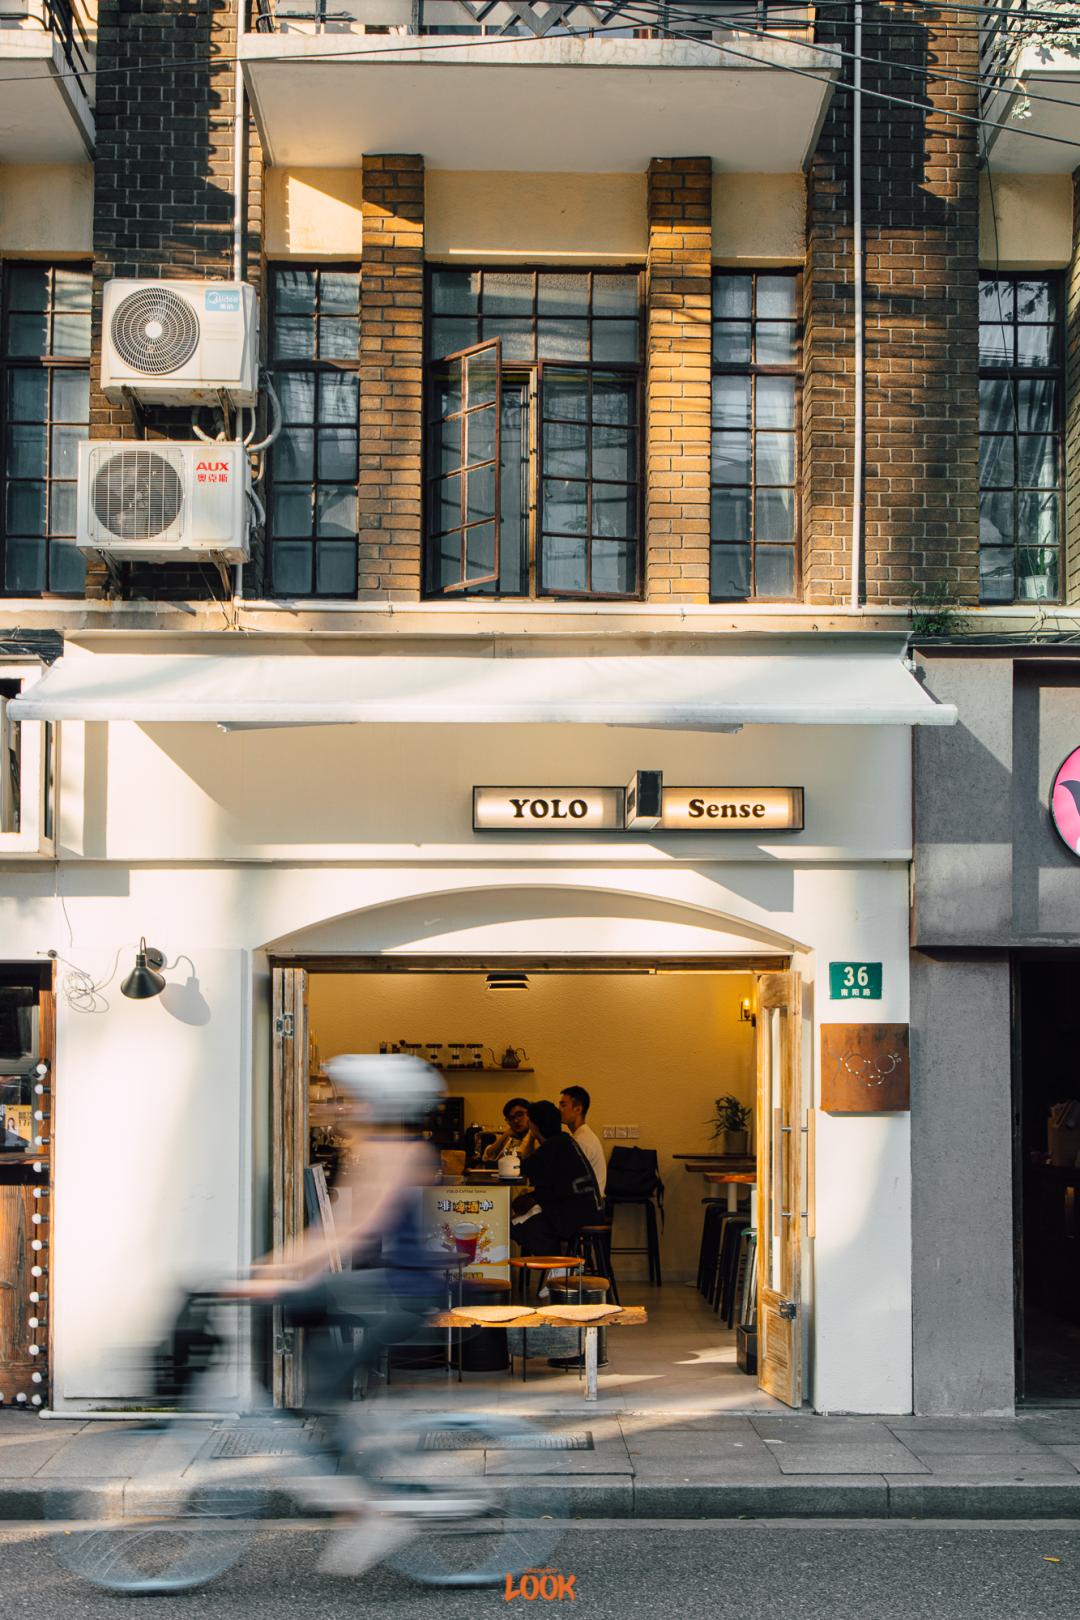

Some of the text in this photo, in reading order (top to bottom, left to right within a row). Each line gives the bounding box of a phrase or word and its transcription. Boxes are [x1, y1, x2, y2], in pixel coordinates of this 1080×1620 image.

[196, 462, 229, 471] AUX
[509, 798, 766, 818] YOLO Sense
[843, 966, 869, 987] 36
